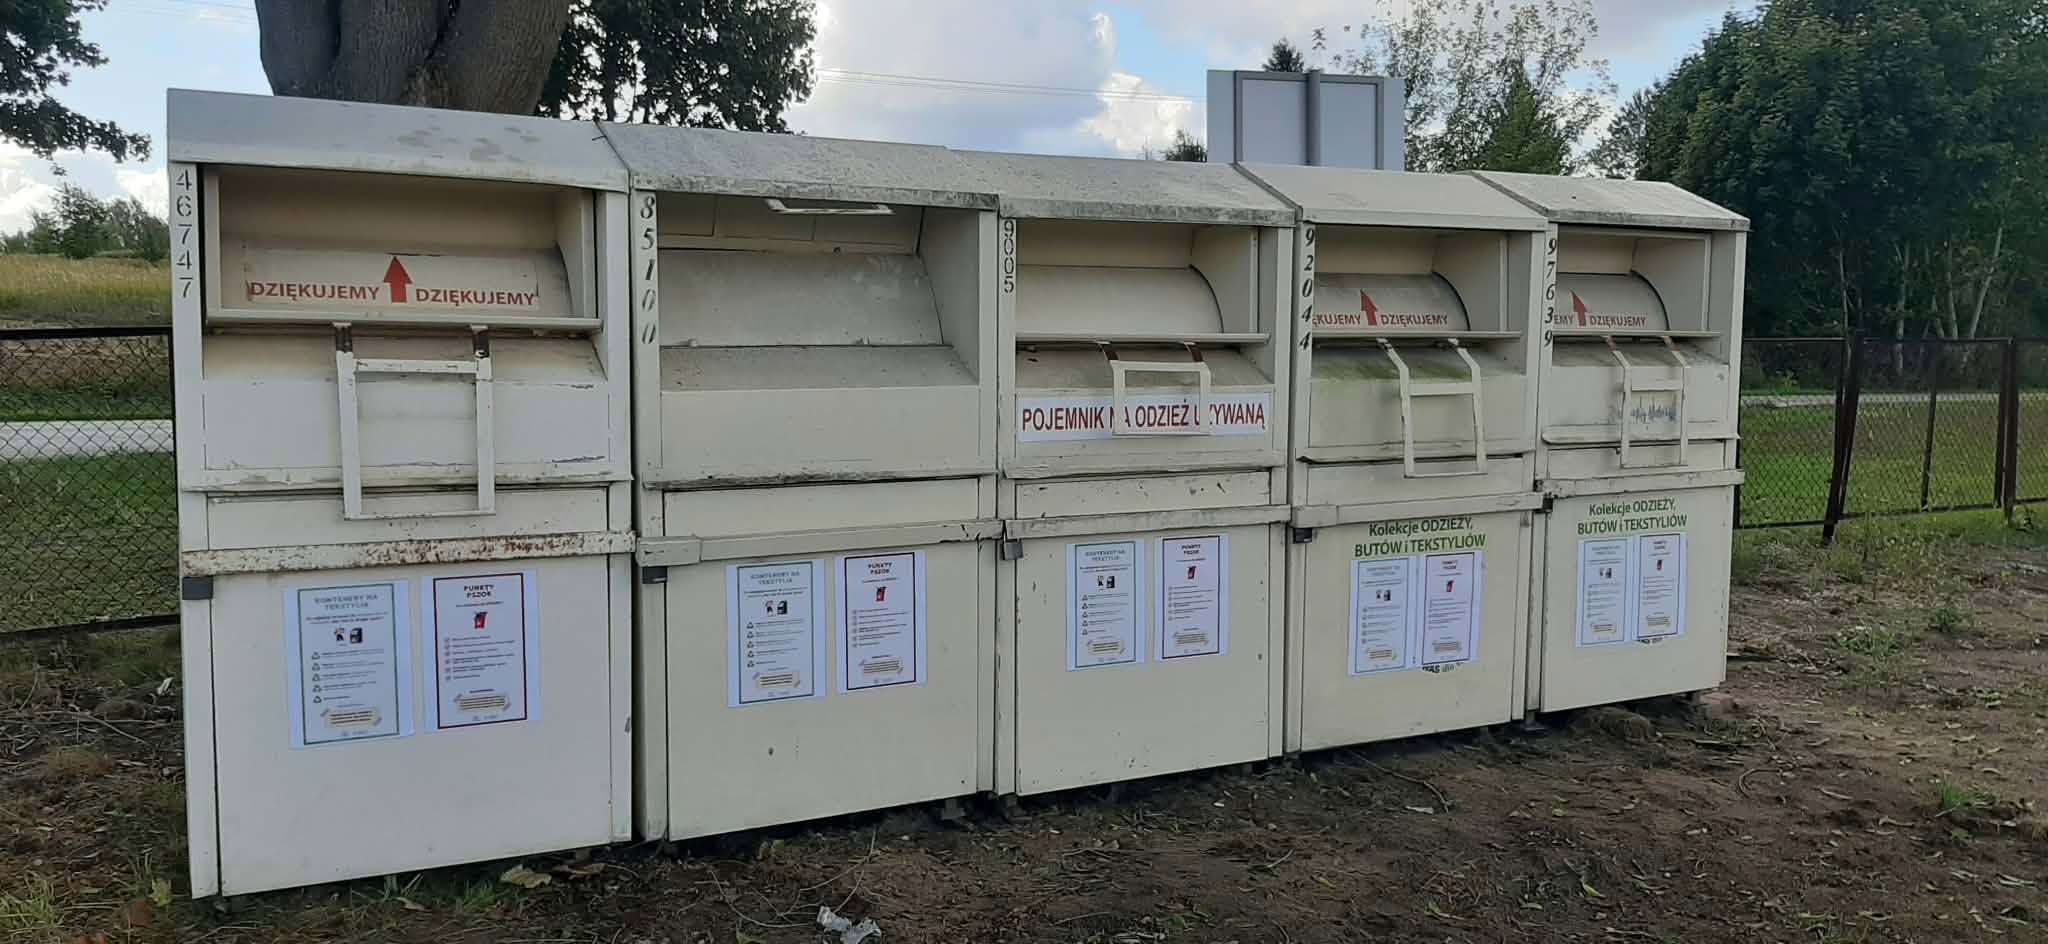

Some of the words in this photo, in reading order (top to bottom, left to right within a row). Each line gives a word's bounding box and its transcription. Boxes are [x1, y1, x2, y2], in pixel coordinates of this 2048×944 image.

[176, 169, 194, 298] 46747
[1003, 219, 1014, 293] 9005
[249, 281, 380, 302] DZIĘKUJEMY
[415, 287, 536, 307] DZIĘKUJEMY
[1300, 227, 1315, 351] 92044
[1544, 238, 1557, 348] 97639
[1380, 313, 1448, 328] DZIĘKUJEMY
[1589, 314, 1647, 329] DZIĘKUJEMY
[1022, 406, 1105, 432] POJEMNIK
[1135, 398, 1189, 428] ODZIEŻ
[1590, 500, 1631, 517] Kolekcje
[1369, 520, 1420, 537] Kolekcje
[1577, 516, 1618, 535] BUTÓW
[1623, 513, 1688, 532] TEKSTYLIÓW
[1354, 538, 1402, 558] BUTÓW
[1411, 532, 1487, 553] TEKSTYLIÓW
